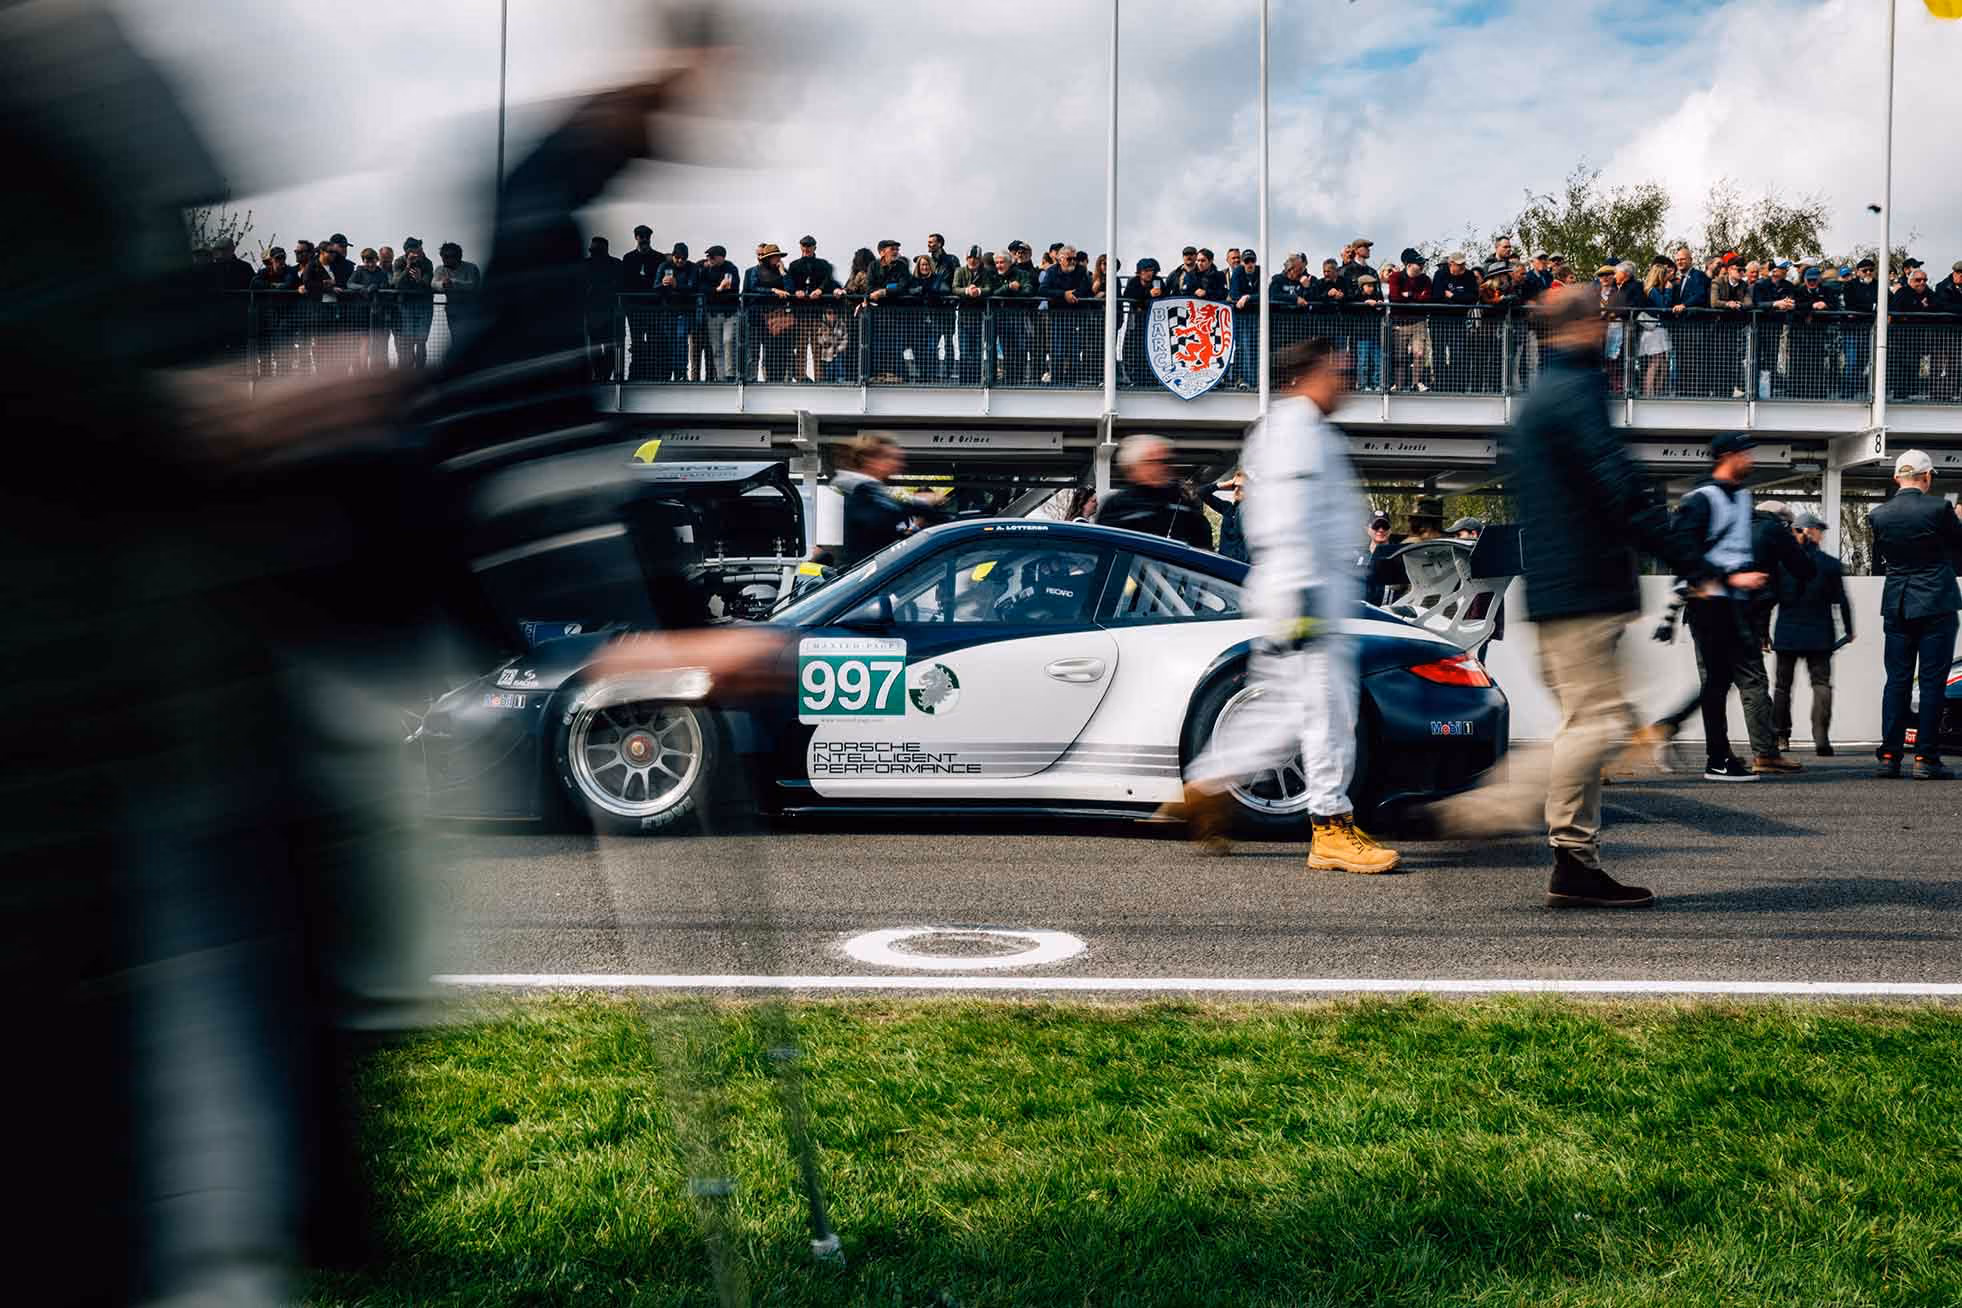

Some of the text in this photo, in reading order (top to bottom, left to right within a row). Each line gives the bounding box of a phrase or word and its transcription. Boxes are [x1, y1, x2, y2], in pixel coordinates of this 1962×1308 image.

[1152, 308, 1167, 369] BARC
[1875, 434, 1882, 453] 8
[1662, 449, 1677, 457] Mr.
[801, 660, 904, 711] 997
[1430, 721, 1462, 736] Mobil
[813, 742, 921, 752] PORSCHE
[813, 753, 958, 763] INTELLIGENT
[813, 763, 982, 774] PERFORMANCE
